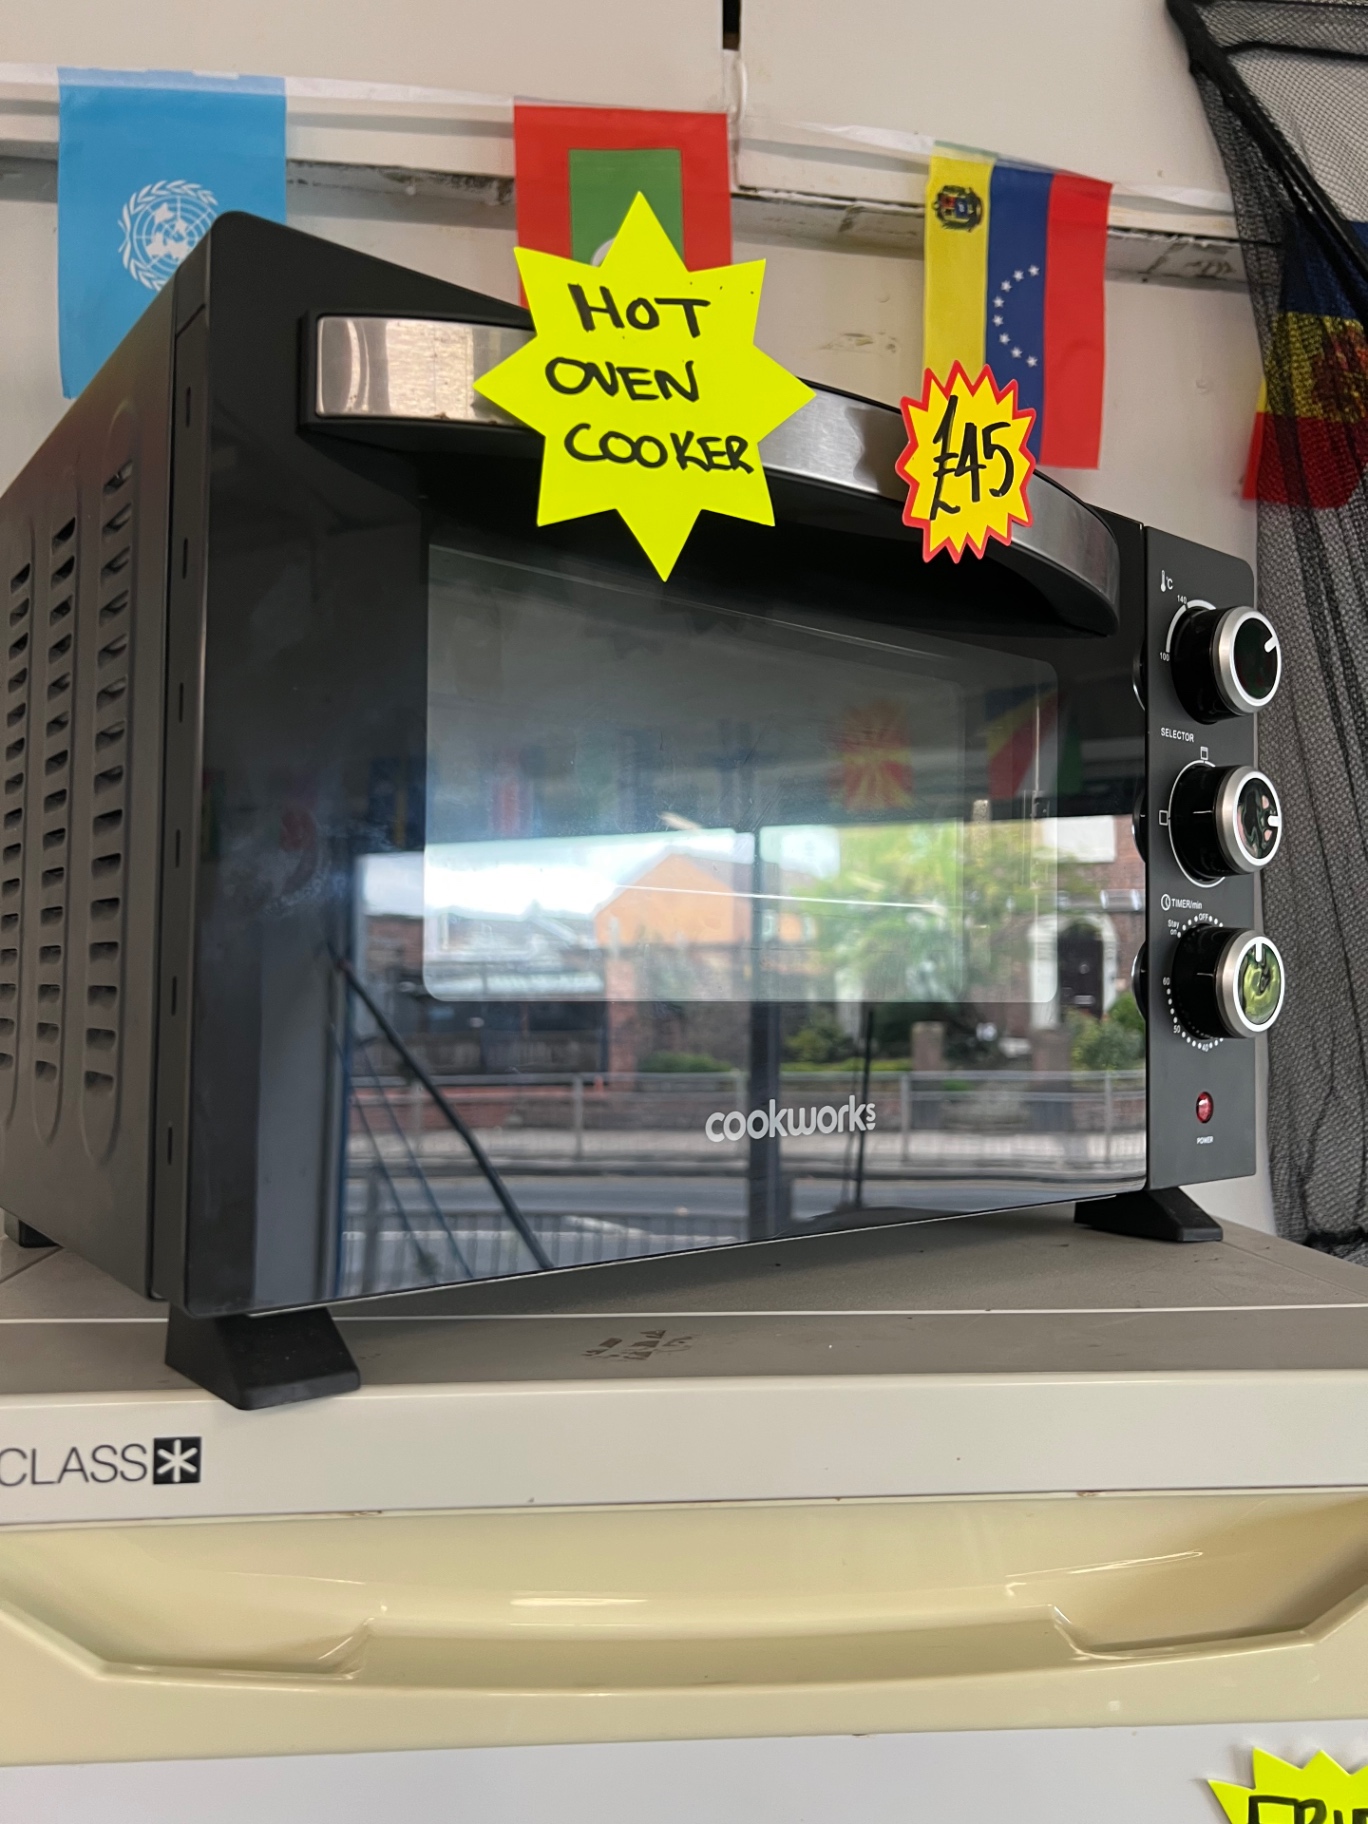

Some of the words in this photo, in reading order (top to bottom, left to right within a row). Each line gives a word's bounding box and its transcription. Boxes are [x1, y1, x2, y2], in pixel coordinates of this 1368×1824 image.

[567, 282, 711, 339] HOT
[544, 356, 700, 403] OVEN
[564, 423, 754, 475] COOKER
[929, 394, 1015, 521] £45
[1159, 652, 1170, 662] 100
[1160, 727, 1195, 743] SELECTOR
[1171, 898, 1203, 910] TIMER/min
[1198, 912, 1209, 921] OFF
[1167, 919, 1180, 930] Stay
[1173, 1024, 1181, 1034] 50
[705, 1095, 877, 1143] cookworks
[0, 1442, 148, 1488] CLASS
